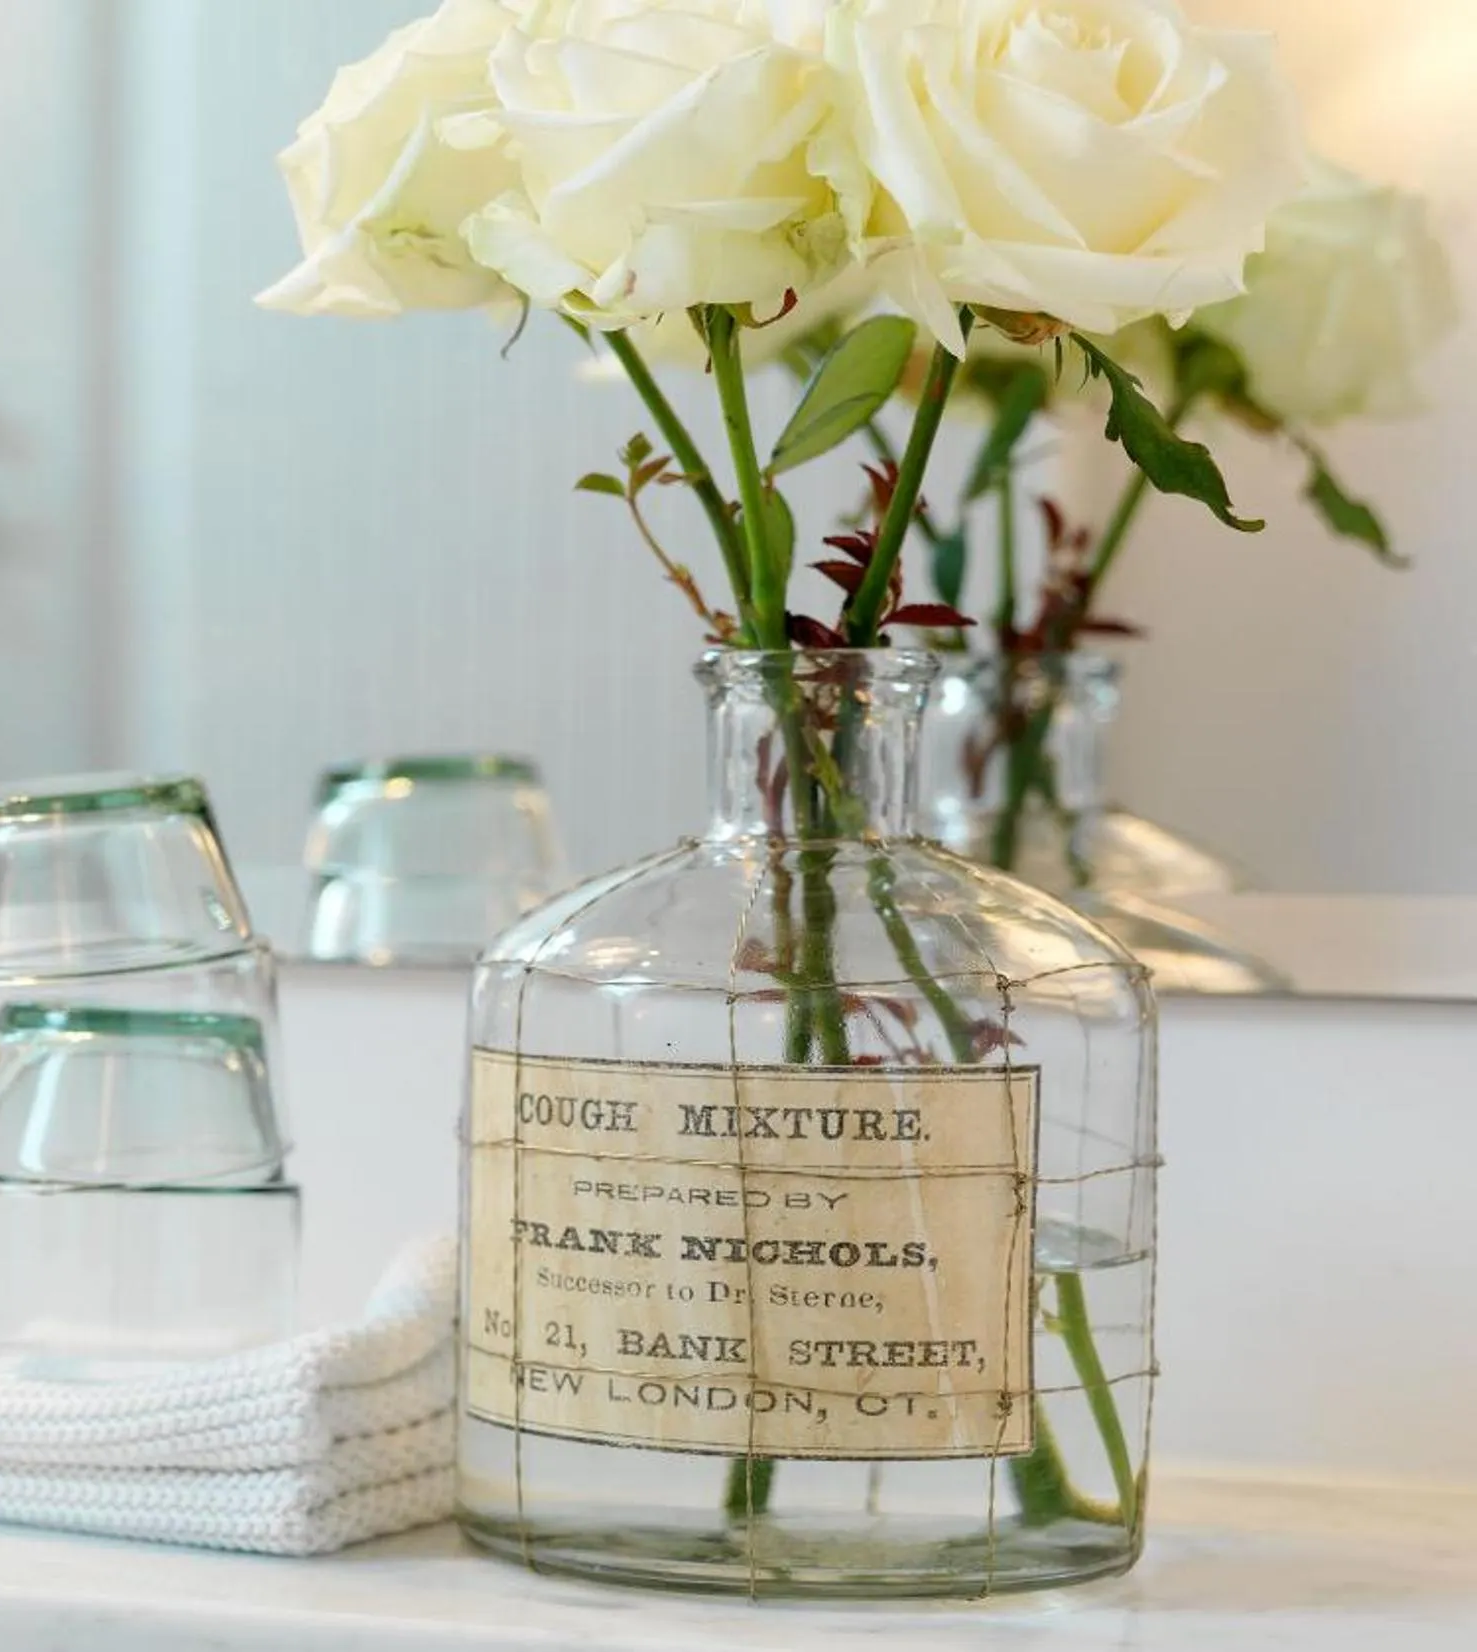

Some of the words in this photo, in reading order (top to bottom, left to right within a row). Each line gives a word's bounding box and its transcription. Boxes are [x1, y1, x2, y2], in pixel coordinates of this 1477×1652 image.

[518, 1092, 638, 1132] COUGH
[678, 1103, 931, 1141] MIXTURE.
[574, 1179, 771, 1208] PREPARED
[785, 1191, 849, 1210] BY
[510, 1217, 662, 1259] FRANK
[680, 1235, 938, 1272] NICHOLS,
[537, 1266, 656, 1299] Successor
[667, 1280, 694, 1300] to
[769, 1282, 885, 1314] Sterne,
[545, 1320, 587, 1358] 21,
[616, 1328, 747, 1364] BANK
[788, 1338, 986, 1374] STREET,
[509, 1364, 584, 1395] NEW
[608, 1377, 828, 1425] LONDON,
[856, 1391, 938, 1420] CT.
